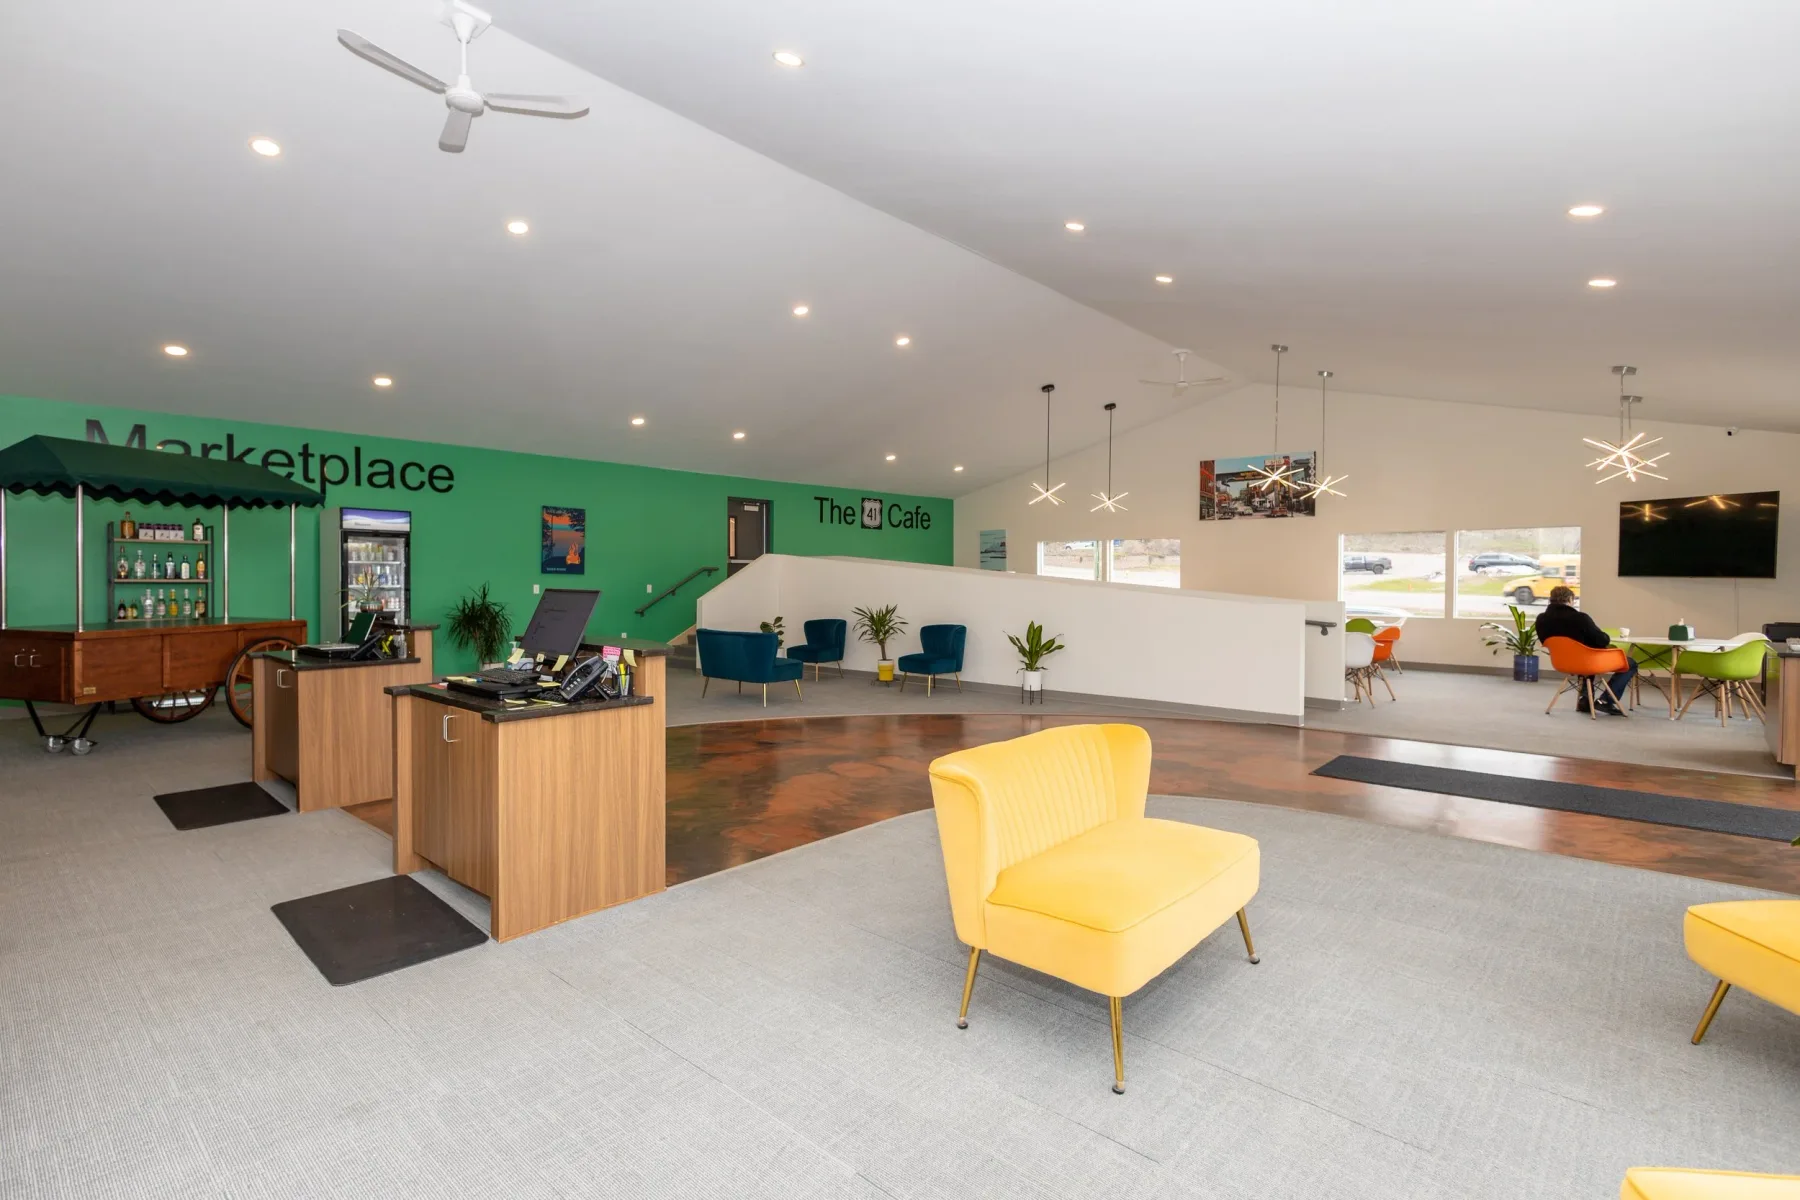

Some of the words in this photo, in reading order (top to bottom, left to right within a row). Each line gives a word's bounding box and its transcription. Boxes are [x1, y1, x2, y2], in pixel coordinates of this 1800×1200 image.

[814, 496, 856, 525] The
[867, 507, 877, 521] 41
[888, 503, 931, 530] Cafe
